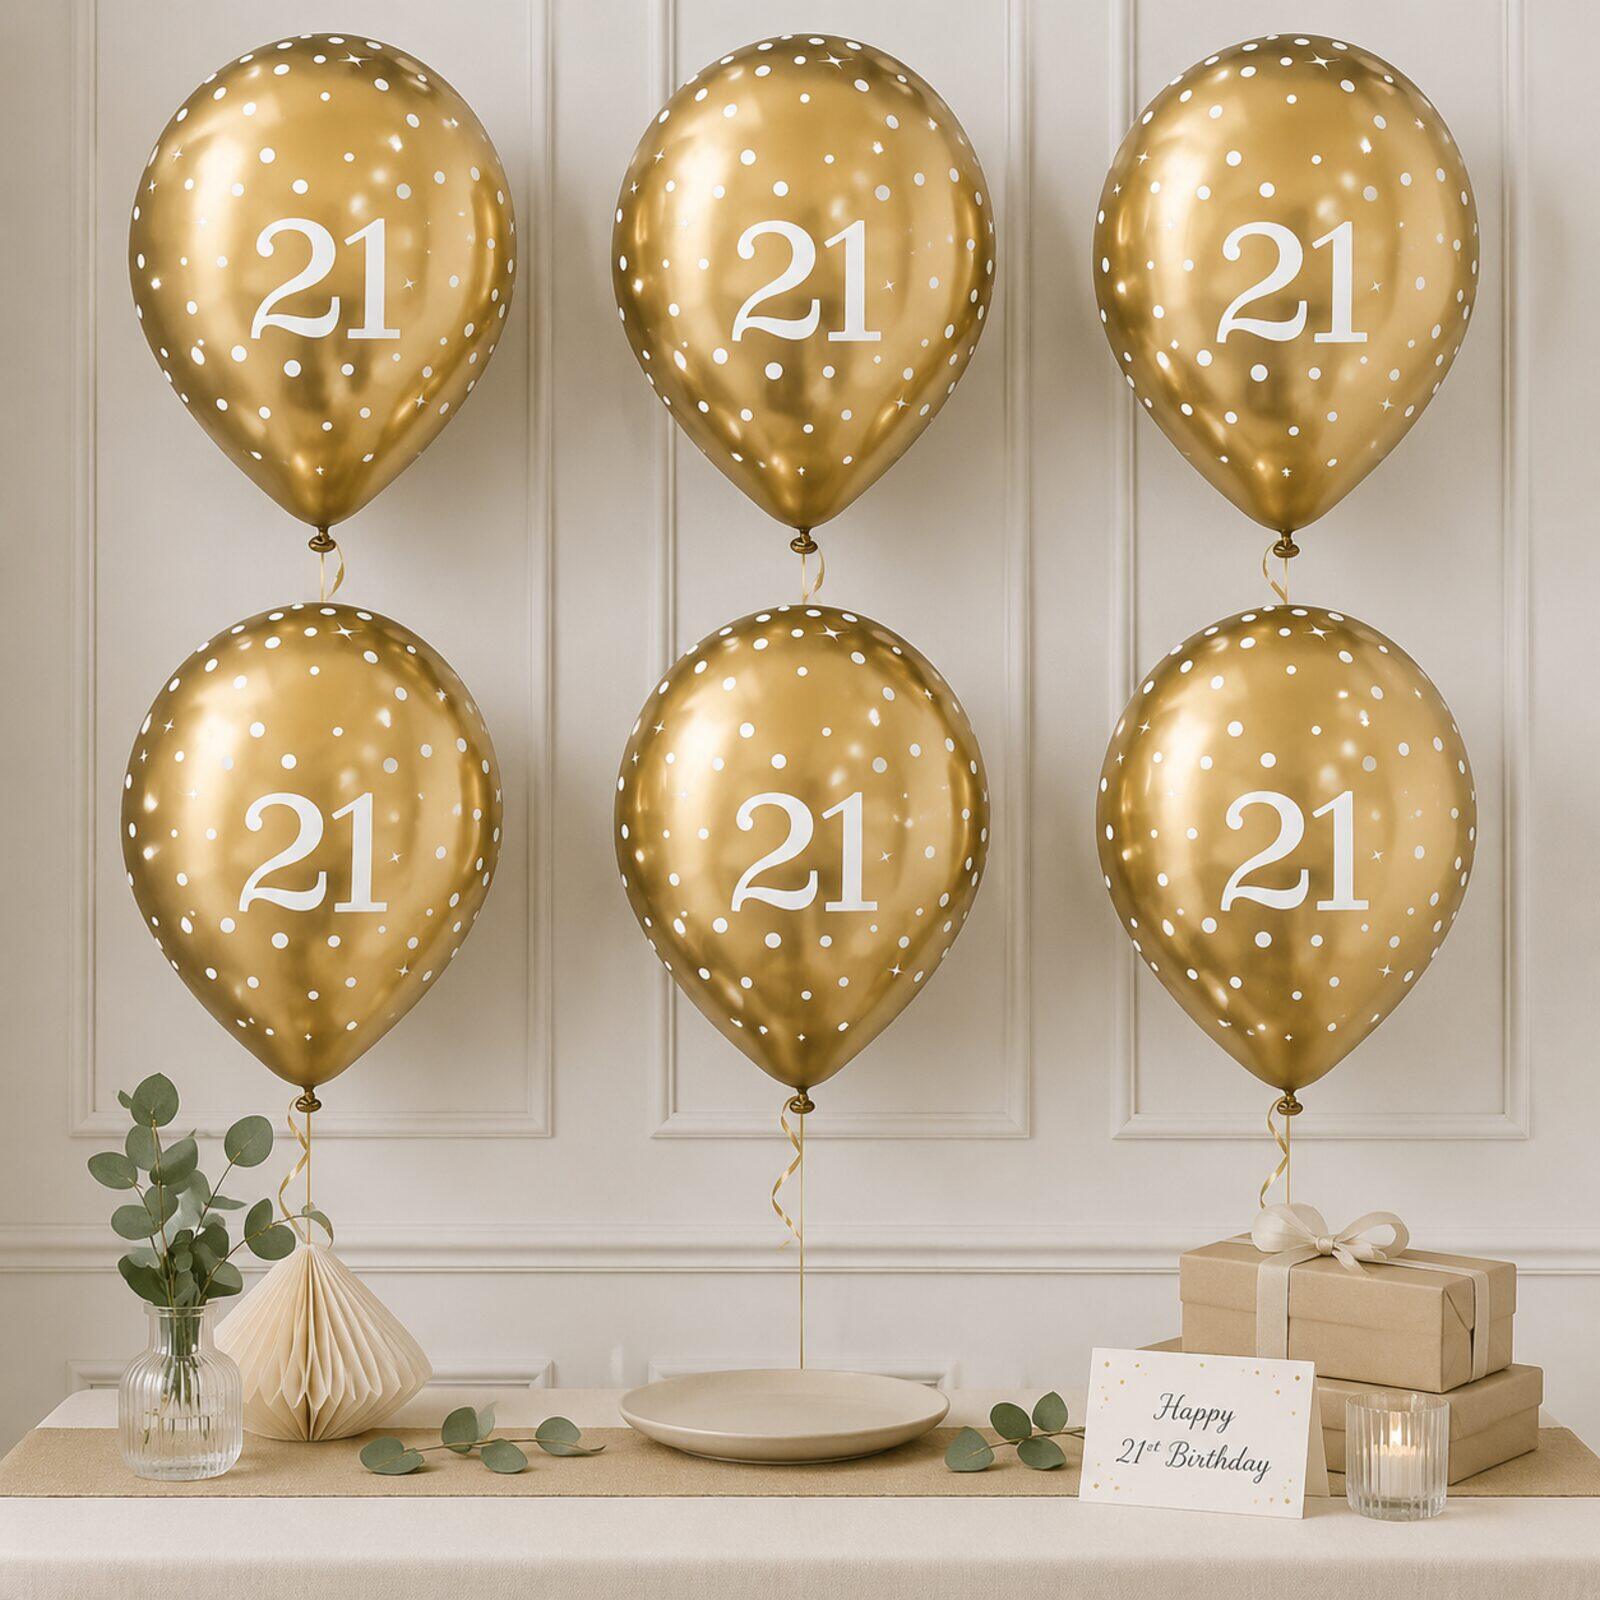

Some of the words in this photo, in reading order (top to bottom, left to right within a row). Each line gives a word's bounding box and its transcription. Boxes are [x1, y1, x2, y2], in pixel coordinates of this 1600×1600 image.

[251, 218, 401, 339] 21
[731, 220, 881, 342] 21
[1216, 221, 1368, 343] 21
[238, 792, 388, 912] 21
[731, 791, 878, 912] 21
[1221, 790, 1369, 911] 21
[1115, 1437, 1161, 1464] 21st
[1165, 1440, 1271, 1484] Birthday
[1153, 1392, 1236, 1433] Happy
